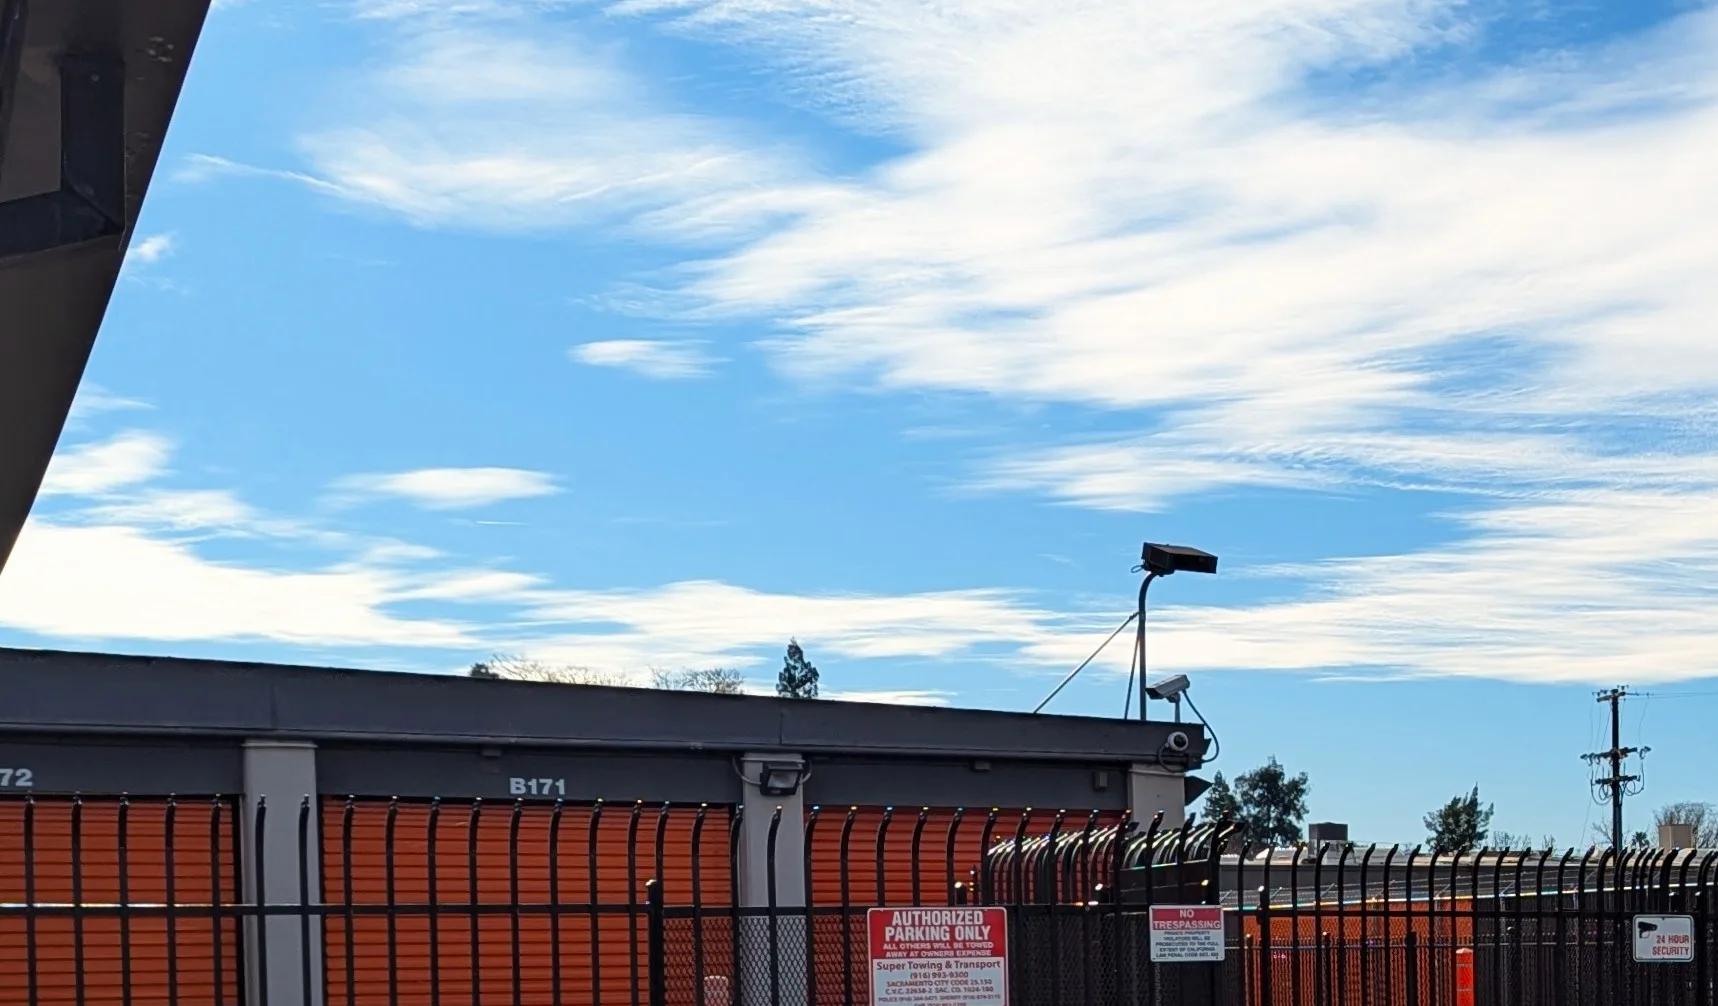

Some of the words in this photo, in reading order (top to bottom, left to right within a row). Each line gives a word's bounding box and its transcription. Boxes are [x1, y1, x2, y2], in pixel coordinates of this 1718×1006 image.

[509, 777, 565, 795] B171
[891, 910, 984, 926] AUTHORIZED
[1179, 909, 1195, 918] NO
[1153, 920, 1221, 930] TRESPASSING
[884, 926, 950, 942] PARKING
[954, 925, 991, 941] ONLY
[1656, 934, 1666, 944] 24
[1668, 934, 1690, 944] HOUR
[1652, 946, 1690, 956] SECURITY
[876, 961, 905, 972] Super
[907, 961, 943, 971] Towing
[944, 961, 952, 969] &
[954, 960, 1001, 971] Transport
[910, 972, 931, 980] (916)
[887, 980, 934, 988] SACRAMENTO
